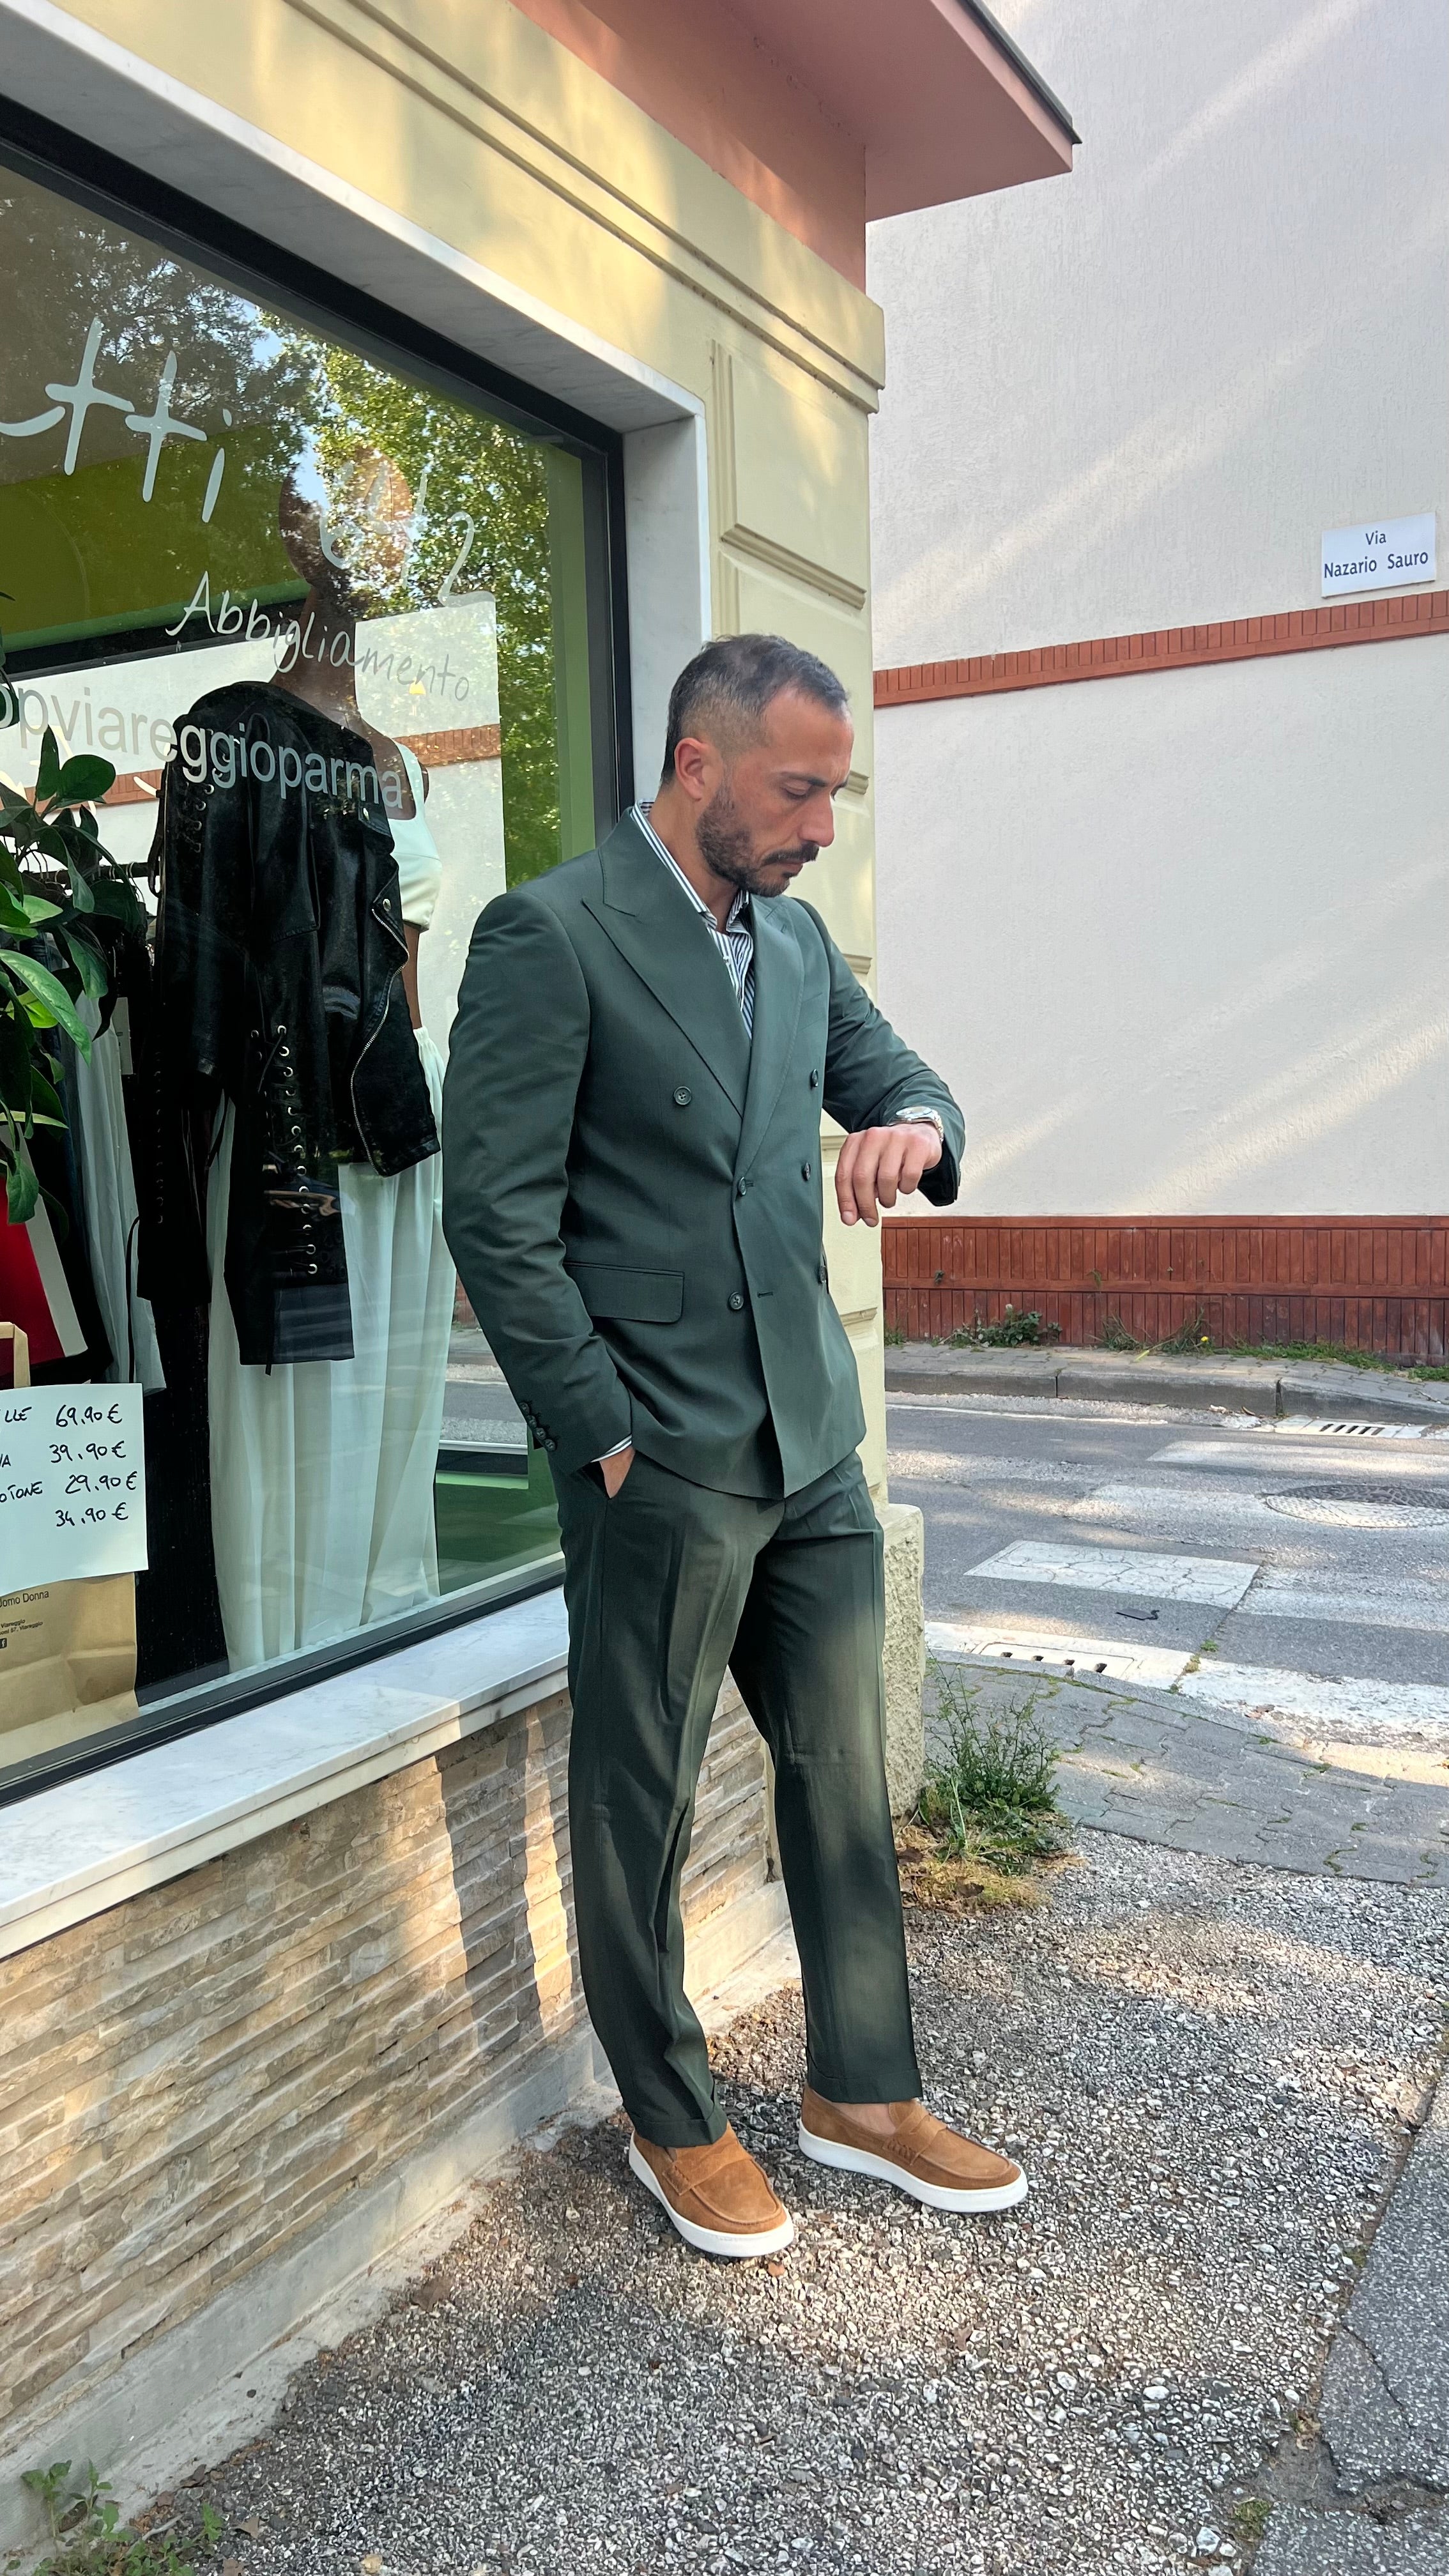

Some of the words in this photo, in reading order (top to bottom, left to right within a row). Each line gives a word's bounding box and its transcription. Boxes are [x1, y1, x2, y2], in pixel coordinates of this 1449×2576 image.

[0, 317, 233, 523] tti
[1365, 530, 1387, 546] Via
[1324, 555, 1377, 578] Nazario
[1387, 551, 1429, 569] Sauro
[165, 570, 469, 702] Abbigliamento
[0, 1406, 32, 1423] LLE
[22, 1590, 49, 1603] Donna
